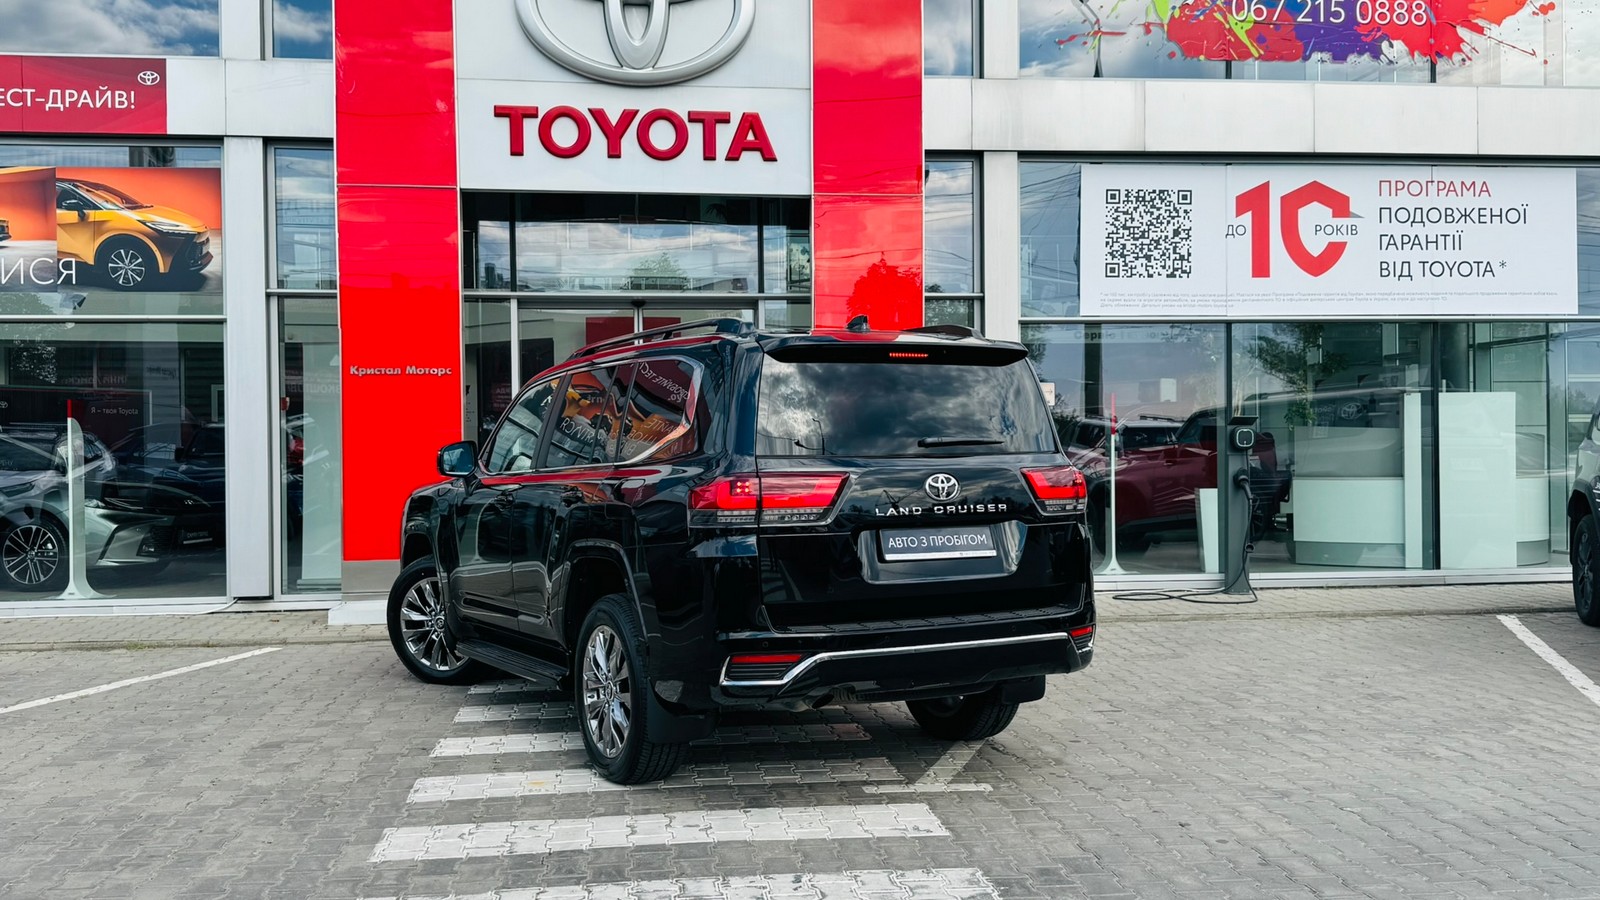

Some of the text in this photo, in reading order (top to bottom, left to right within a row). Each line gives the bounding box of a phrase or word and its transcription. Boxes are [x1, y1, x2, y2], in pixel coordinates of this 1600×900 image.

[1232, 0, 1427, 25] 067 215 0888
[493, 105, 777, 162] TOYOTA
[1378, 180, 1491, 197] ПРОГРАМА
[1379, 204, 1529, 228] ПОДОВЖЕНОЇ
[1225, 224, 1247, 239] ДО
[1314, 224, 1358, 236] РОКІВ
[1379, 230, 1464, 251] ГАРАНТІЇ
[1, 257, 76, 285] ИСЯ
[1379, 261, 1412, 282] ВІД
[349, 365, 452, 377] Кристал Моторс
[118, 407, 139, 416] Toyota
[875, 503, 1008, 517] LAND CRUISER
[888, 536, 919, 549] АВТО
[929, 533, 988, 547] ПРОБІГОМ
